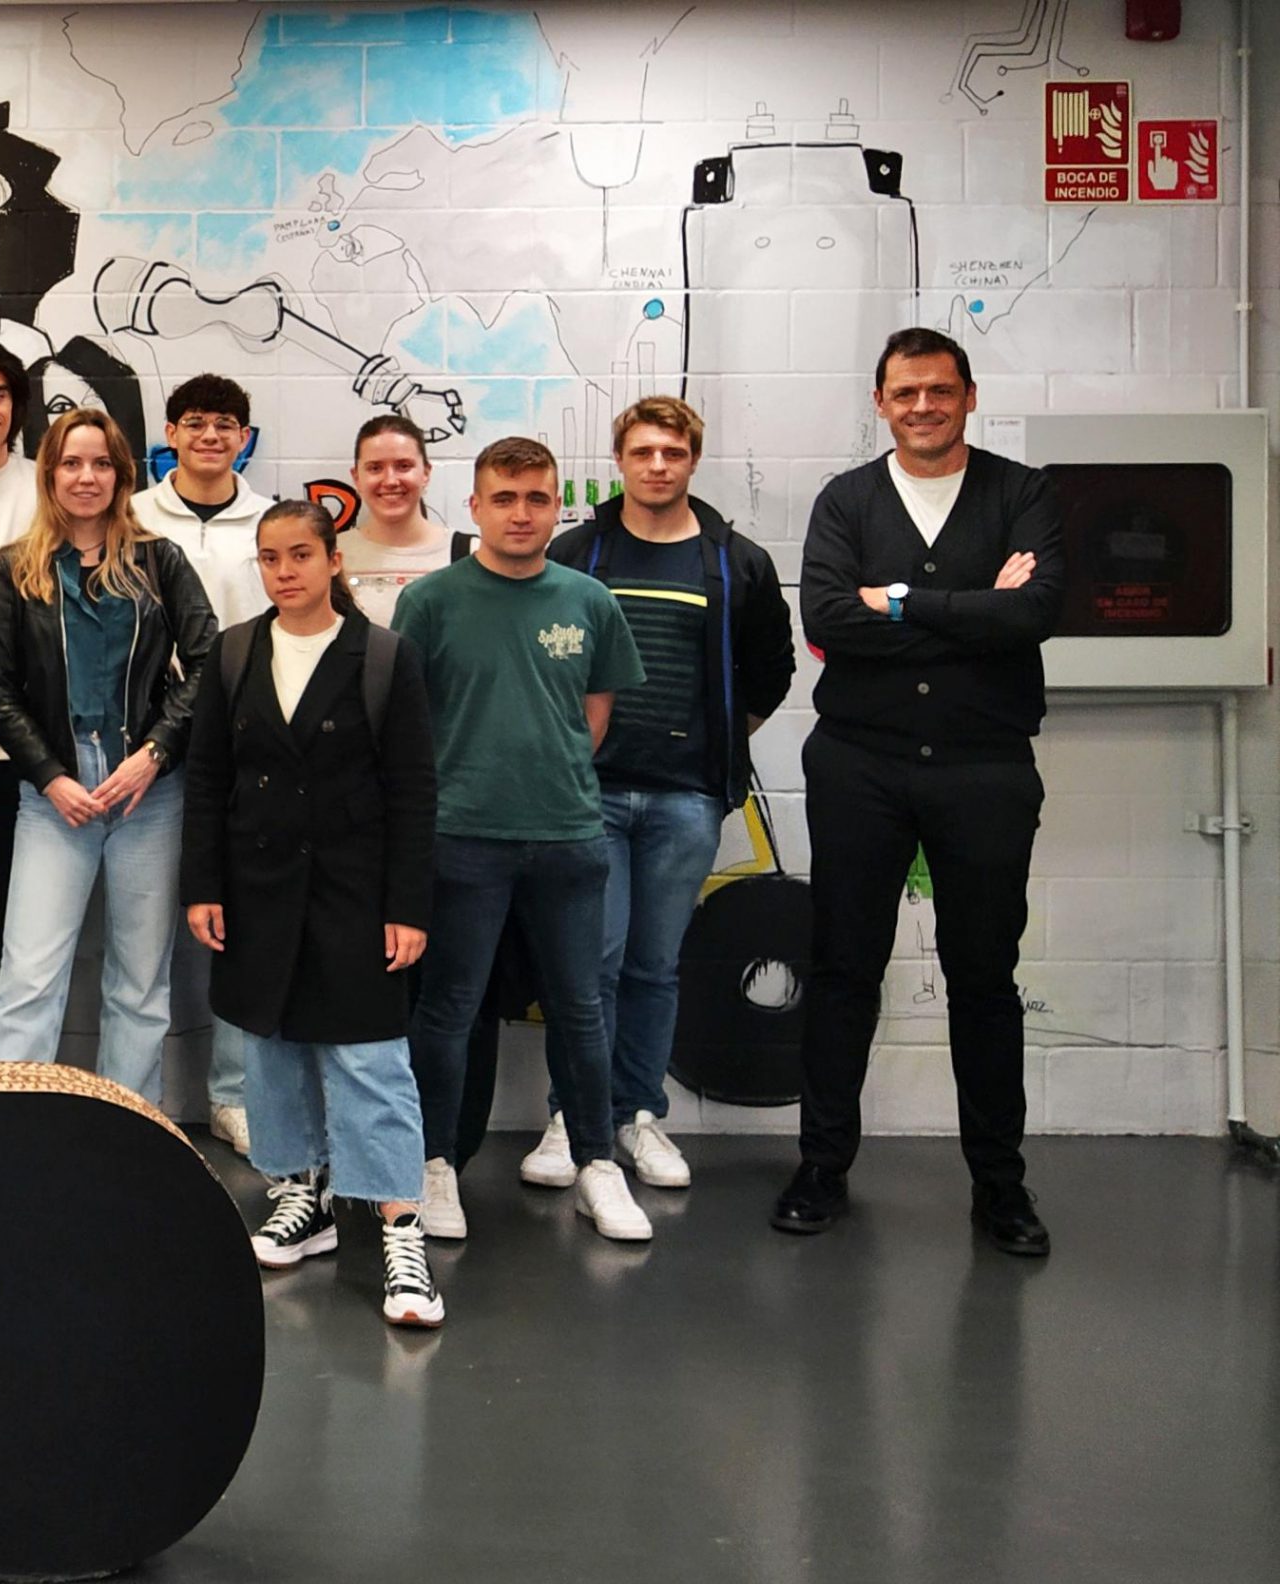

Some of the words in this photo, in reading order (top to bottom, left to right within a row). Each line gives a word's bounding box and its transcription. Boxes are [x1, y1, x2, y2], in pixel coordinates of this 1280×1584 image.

[1057, 172, 1096, 184] BOCA
[1099, 172, 1117, 183] DE
[1055, 187, 1119, 198] INCENDIO
[609, 267, 672, 279] CHENNAI
[954, 274, 1008, 287] (CHINA)
